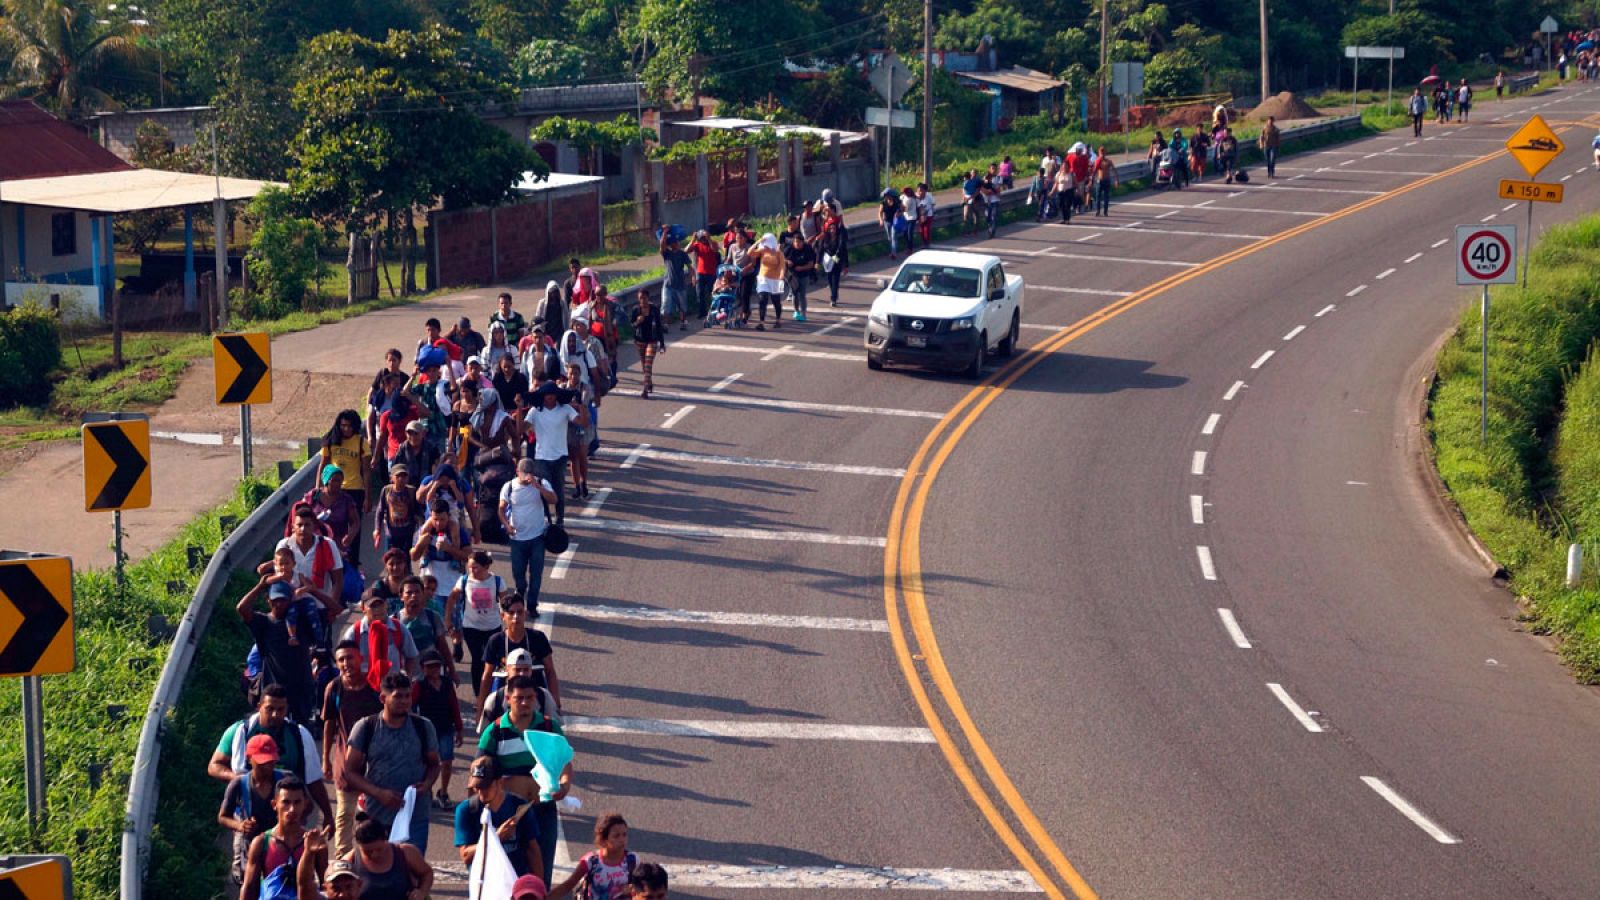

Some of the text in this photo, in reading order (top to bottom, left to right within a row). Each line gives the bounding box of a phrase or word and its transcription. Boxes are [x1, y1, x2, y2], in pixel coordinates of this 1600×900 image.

[1507, 184, 1556, 199] A 150 m
[1471, 242, 1501, 263] 40
